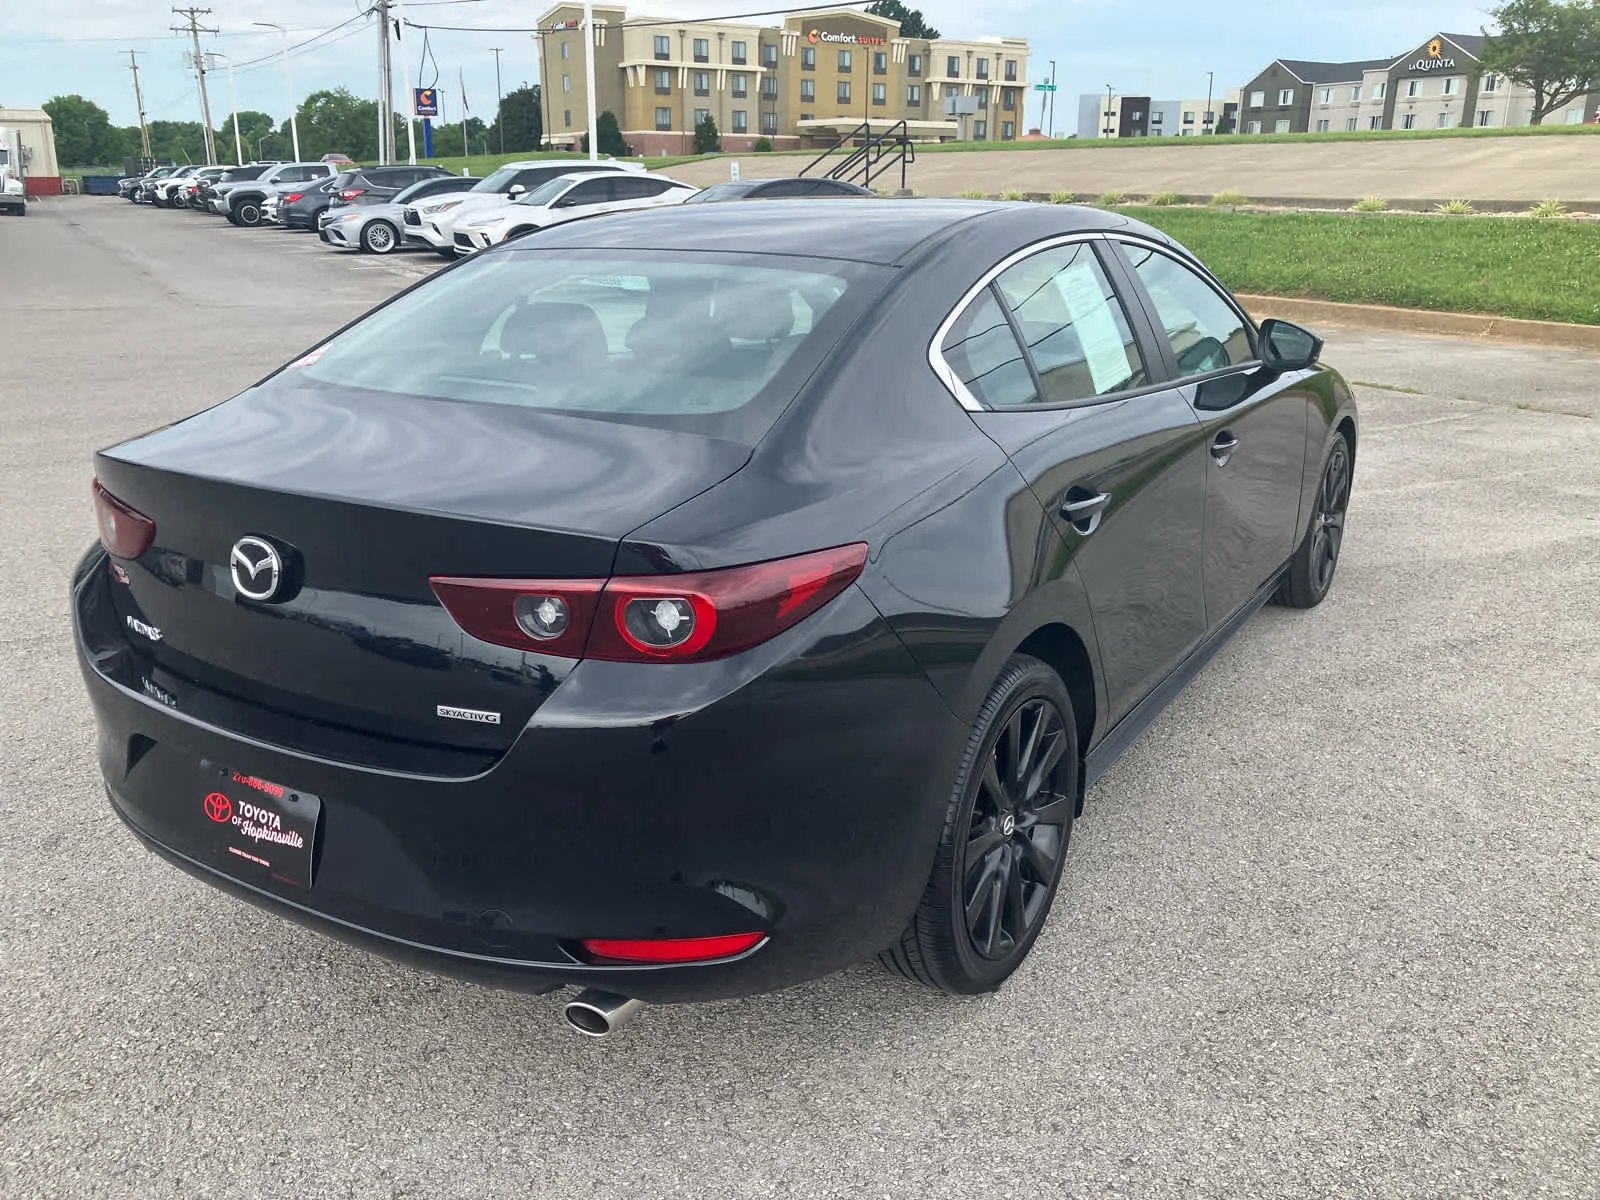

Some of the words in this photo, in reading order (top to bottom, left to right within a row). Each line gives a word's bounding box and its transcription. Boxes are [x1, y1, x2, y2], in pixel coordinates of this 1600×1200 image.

[821, 31, 856, 44] Comfort
[858, 36, 885, 46] SUITES
[1408, 63, 1417, 71] LA
[1416, 58, 1455, 71] QUINTA
[238, 800, 281, 830] TOYOTA
[231, 815, 242, 827] OF
[240, 820, 304, 848] Hopkinsville
